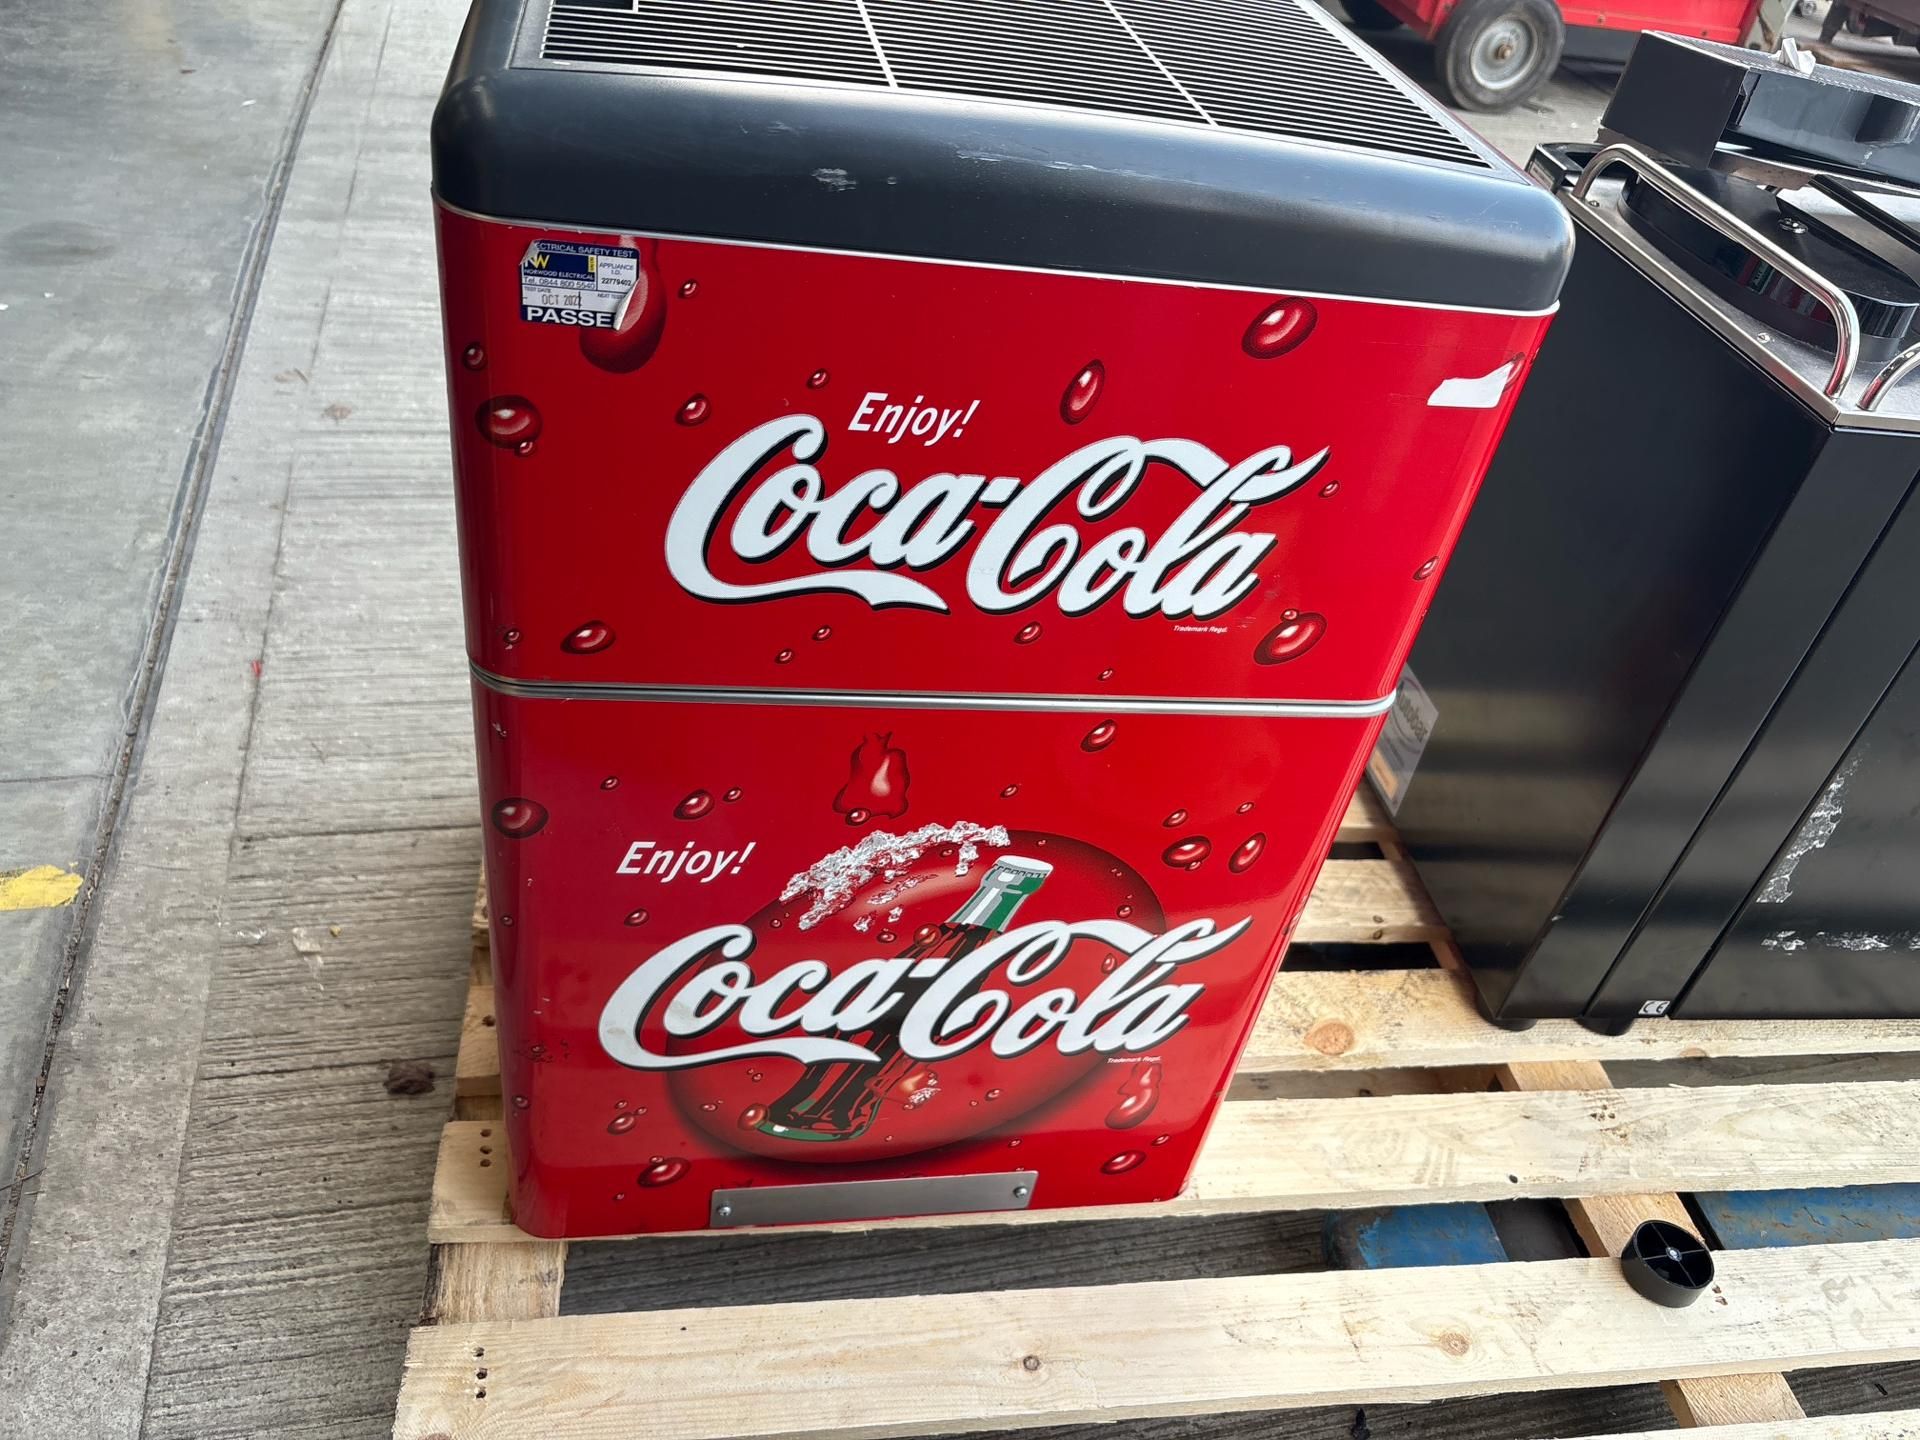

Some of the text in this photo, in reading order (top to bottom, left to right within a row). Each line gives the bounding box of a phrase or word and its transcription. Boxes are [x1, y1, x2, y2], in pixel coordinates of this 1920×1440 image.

[534, 242, 633, 258] ECTRICAL SAFETY TEST
[524, 269, 594, 280] NORWOOD ELECTRICAL
[599, 262, 634, 271] APPLIANCE
[538, 278, 558, 286] 0844
[560, 280, 574, 288] 800
[576, 281, 595, 290] 5540
[541, 294, 559, 306] OCT
[527, 307, 612, 327] PASSE
[847, 391, 981, 446] Enjoy!
[664, 412, 1330, 618] Coca-Cola
[1397, 681, 1428, 742] utobar
[615, 841, 757, 884] Enjoy!
[598, 915, 1253, 1069] Coca-Cola
